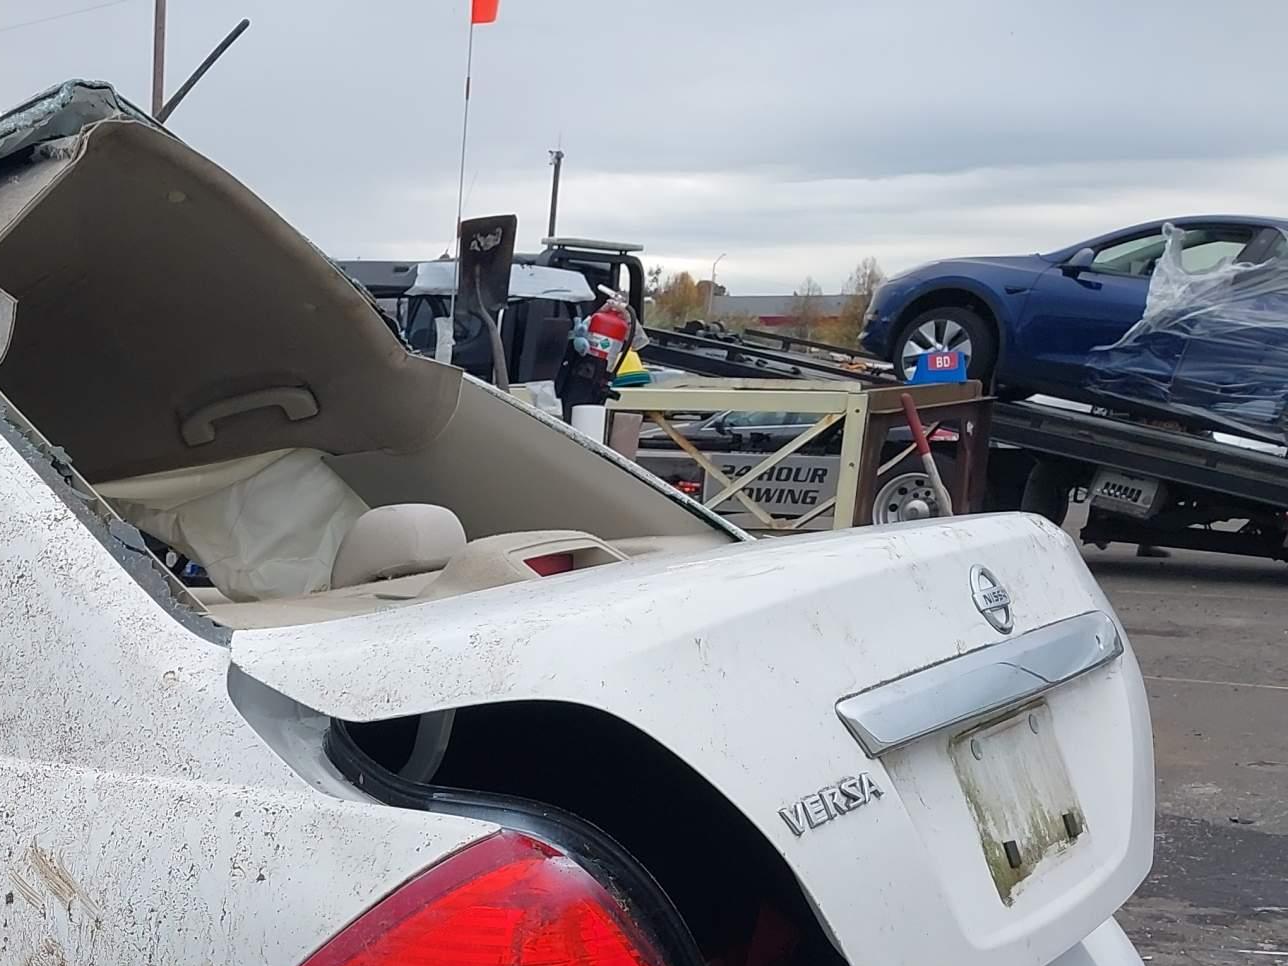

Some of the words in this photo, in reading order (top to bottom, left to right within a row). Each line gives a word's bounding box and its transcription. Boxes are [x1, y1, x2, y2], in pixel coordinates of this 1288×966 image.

[935, 355, 951, 369] BD
[729, 486, 820, 506] OWING
[776, 772, 885, 837] VERSA
